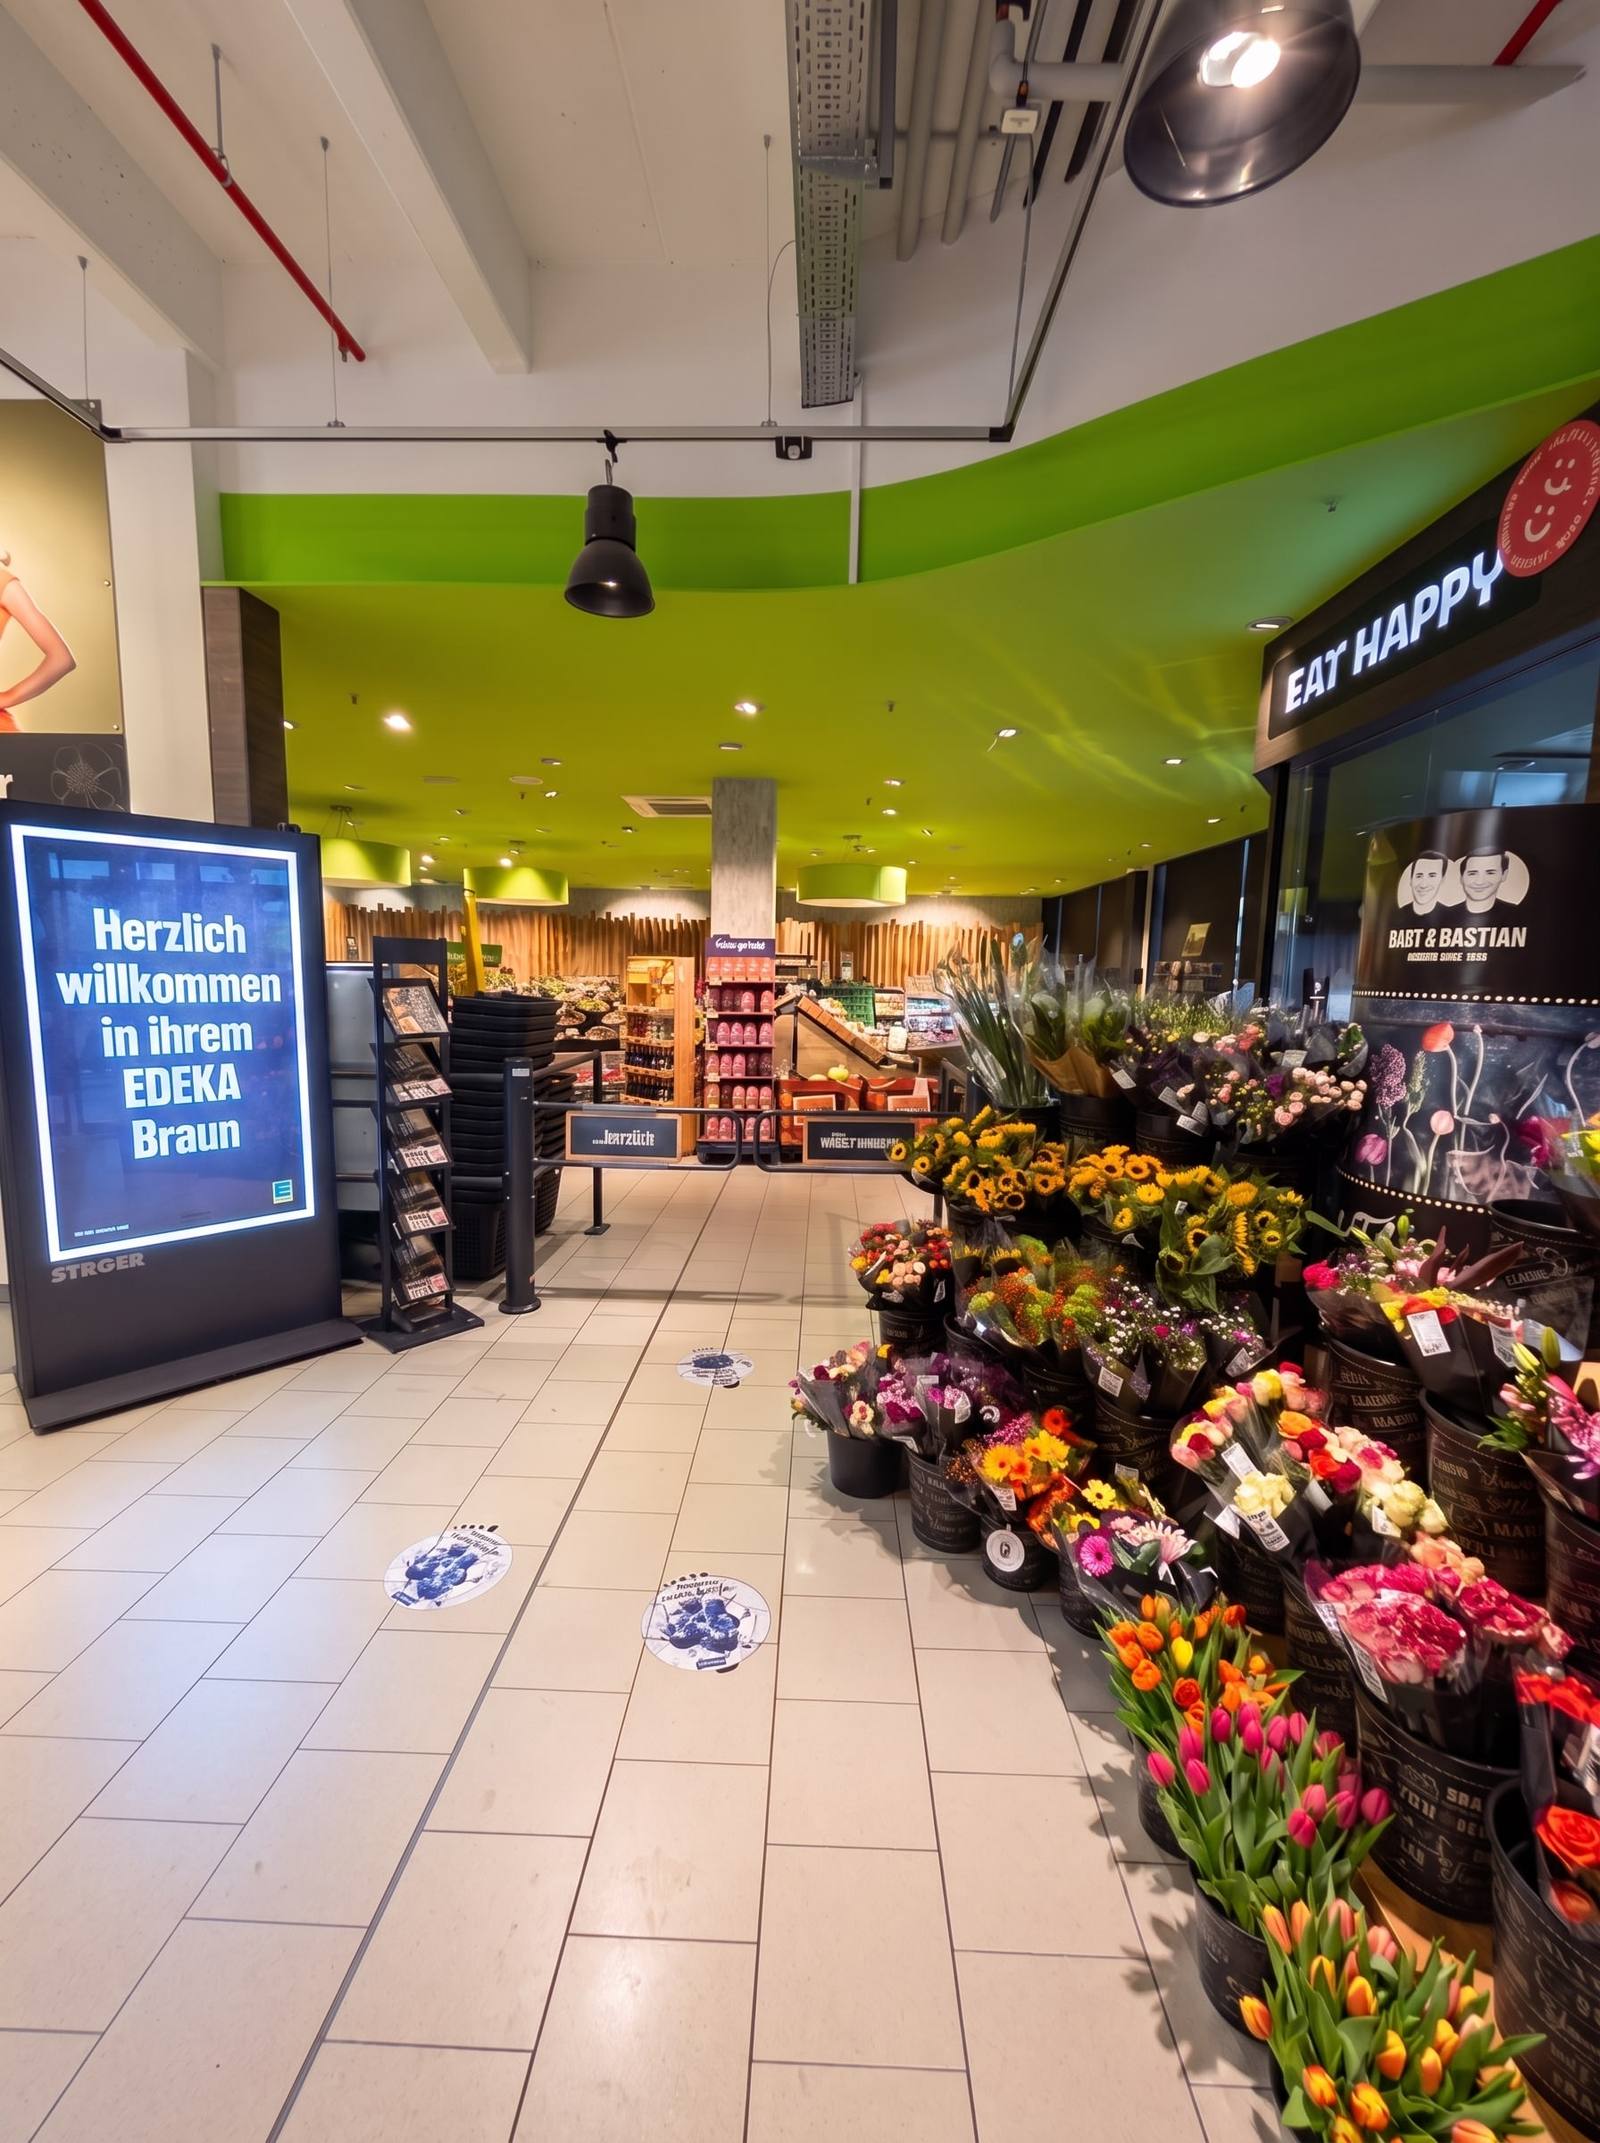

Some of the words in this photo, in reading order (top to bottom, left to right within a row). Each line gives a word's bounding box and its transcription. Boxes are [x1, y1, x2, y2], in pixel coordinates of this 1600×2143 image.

[1285, 640, 1348, 713] EAT
[1353, 550, 1504, 675] HAPPY
[93, 907, 247, 953] Herzlich
[1425, 928, 1437, 947] &
[1439, 927, 1527, 948] BASTIAN
[56, 962, 282, 1005] willkommen
[101, 1016, 139, 1057] in
[148, 1015, 253, 1056] ihrem
[123, 1063, 242, 1109] EDEKA
[131, 1118, 241, 1160] Braun
[51, 1252, 146, 1284] STRGER
